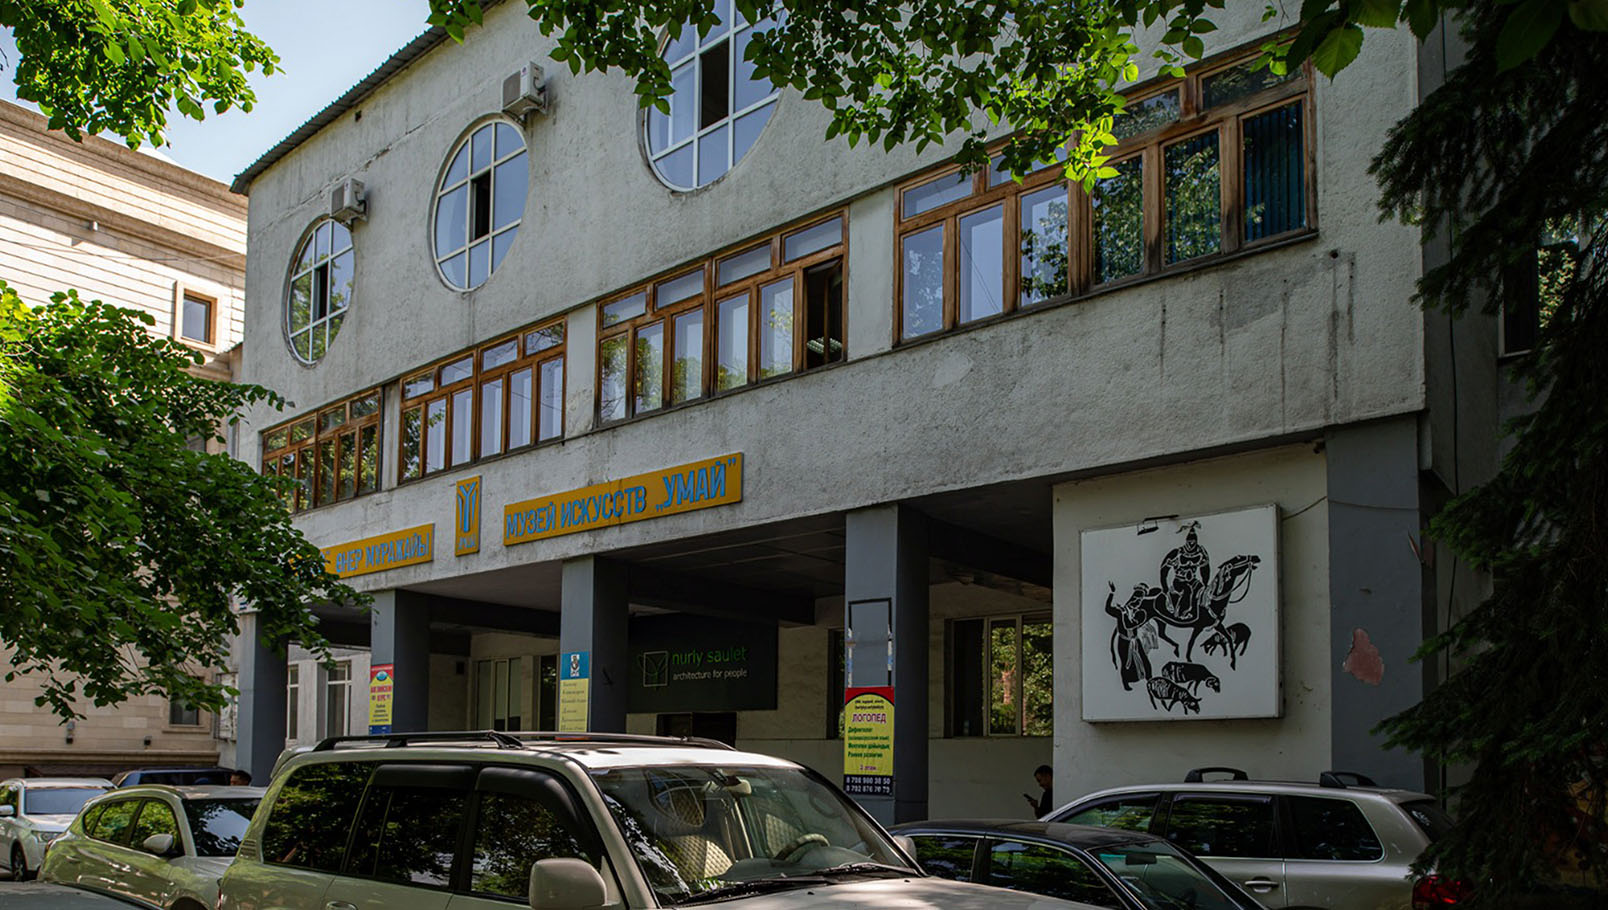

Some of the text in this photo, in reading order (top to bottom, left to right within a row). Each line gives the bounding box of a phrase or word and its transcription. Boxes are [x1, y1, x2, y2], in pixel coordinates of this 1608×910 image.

[505, 501, 556, 539] МУЗЕЙ
[560, 485, 647, 528] ИСКУССТВ
[335, 548, 363, 573] ӨНЕР
[707, 647, 747, 663] saulet
[672, 668, 748, 681] architecture for people
[853, 713, 886, 724] ЛОГОПЕД
